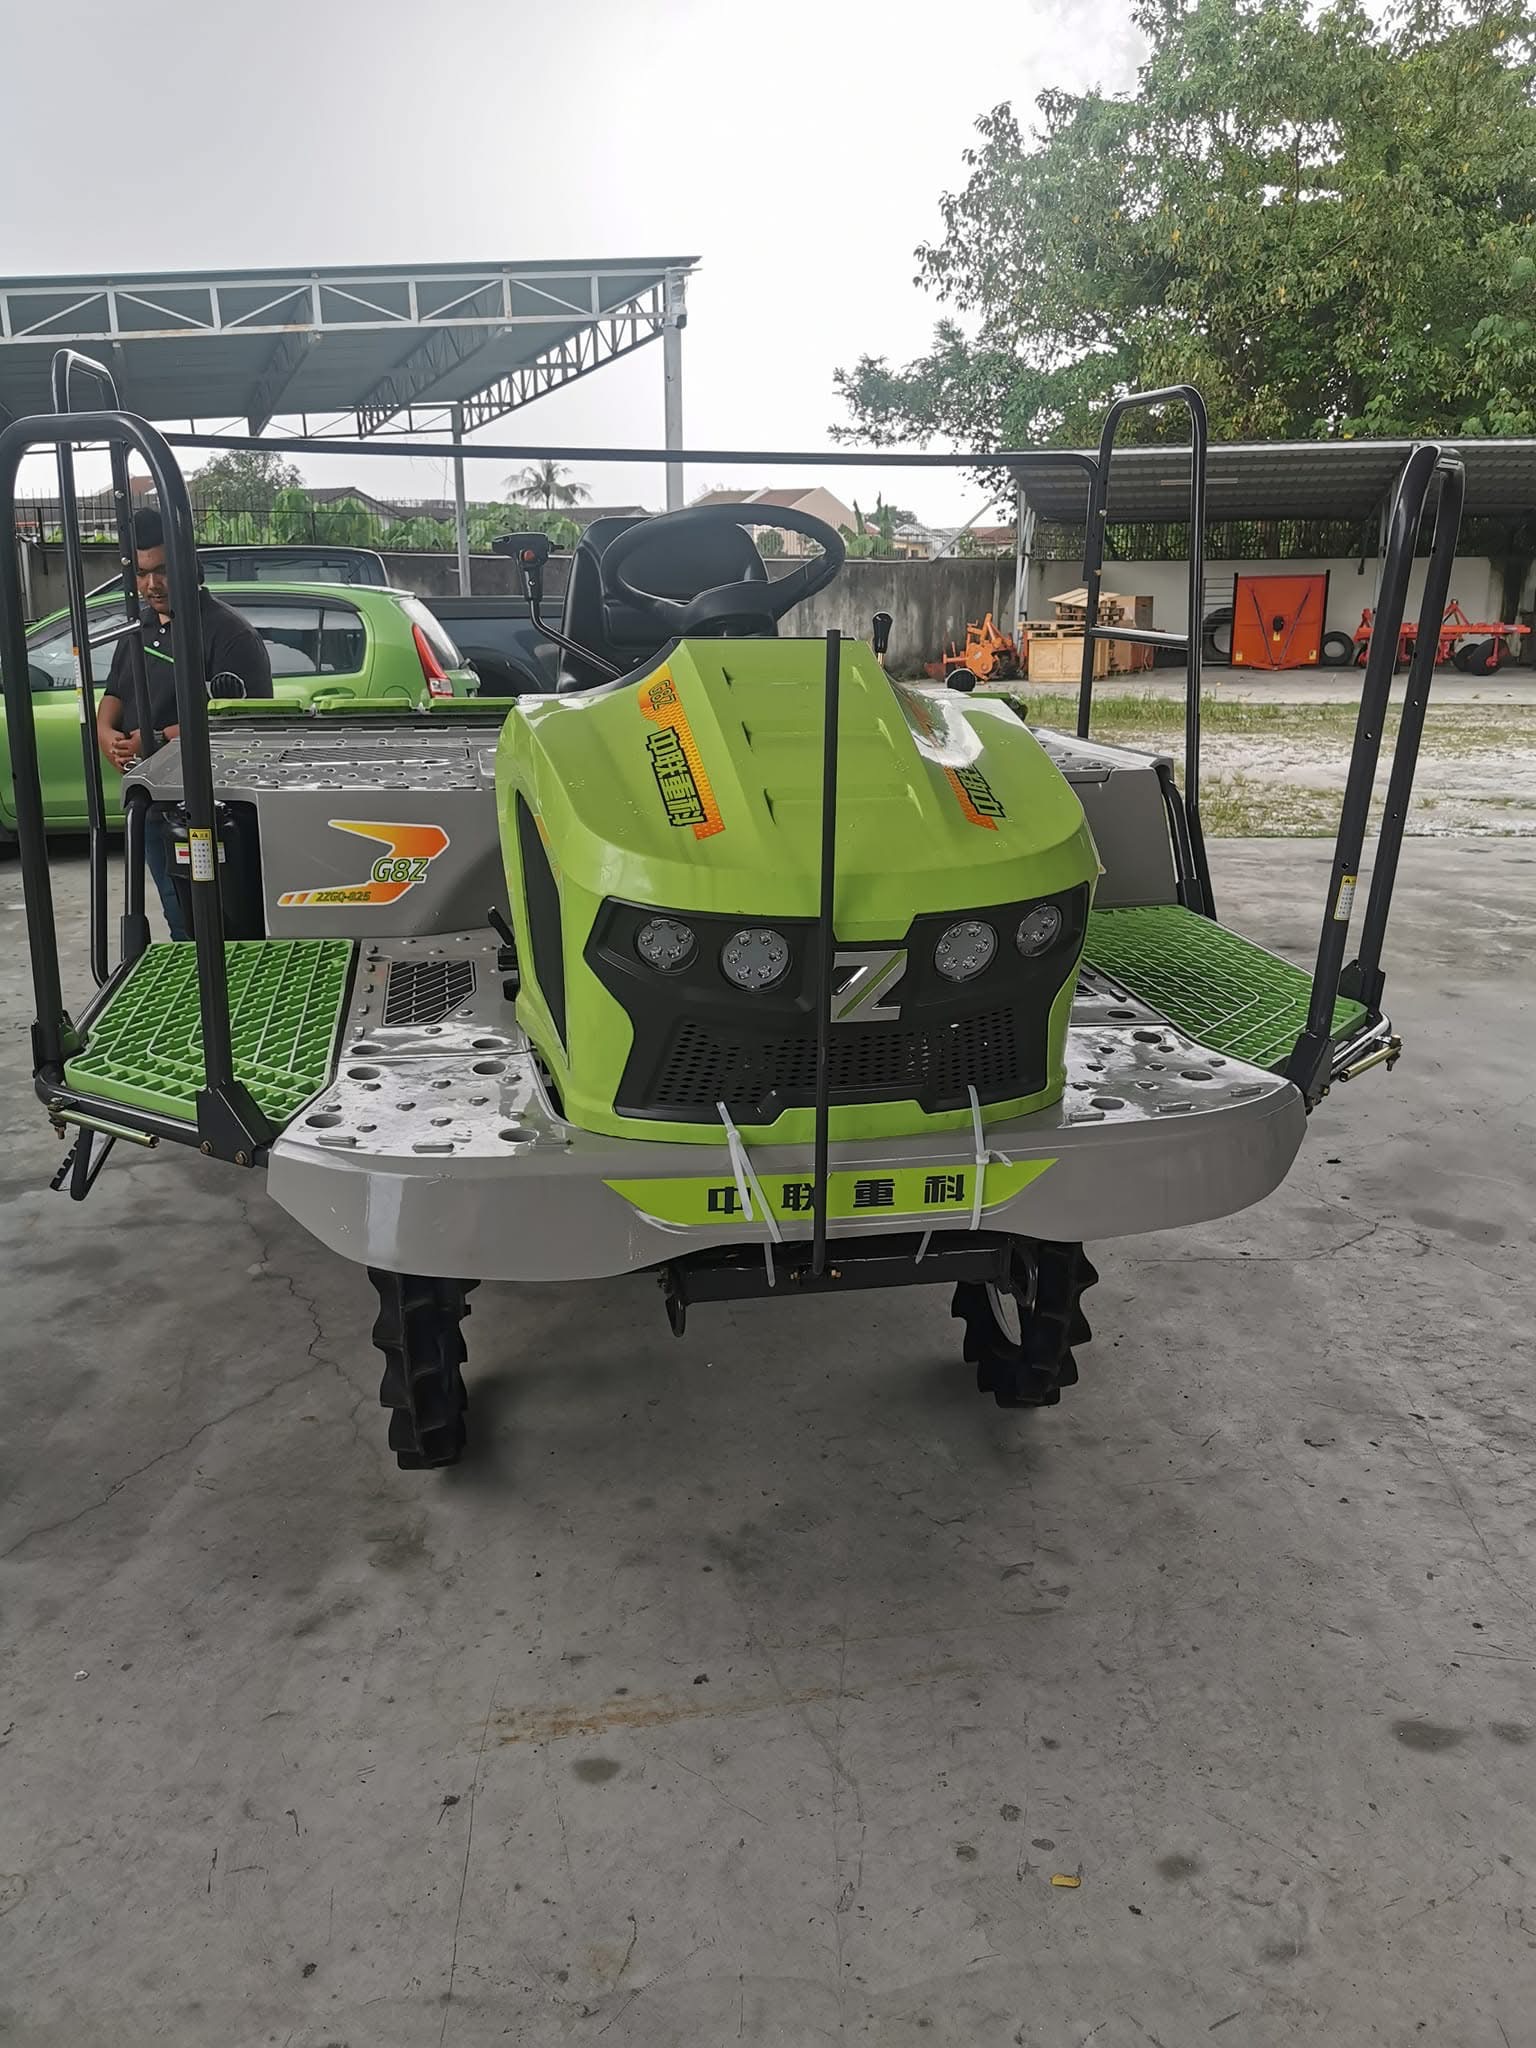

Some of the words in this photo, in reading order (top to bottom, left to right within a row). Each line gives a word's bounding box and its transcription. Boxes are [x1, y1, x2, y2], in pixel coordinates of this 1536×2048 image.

[645, 725, 708, 827] 中联重科
[372, 857, 430, 883] G8Z
[707, 1174, 965, 1215] 中联重科
